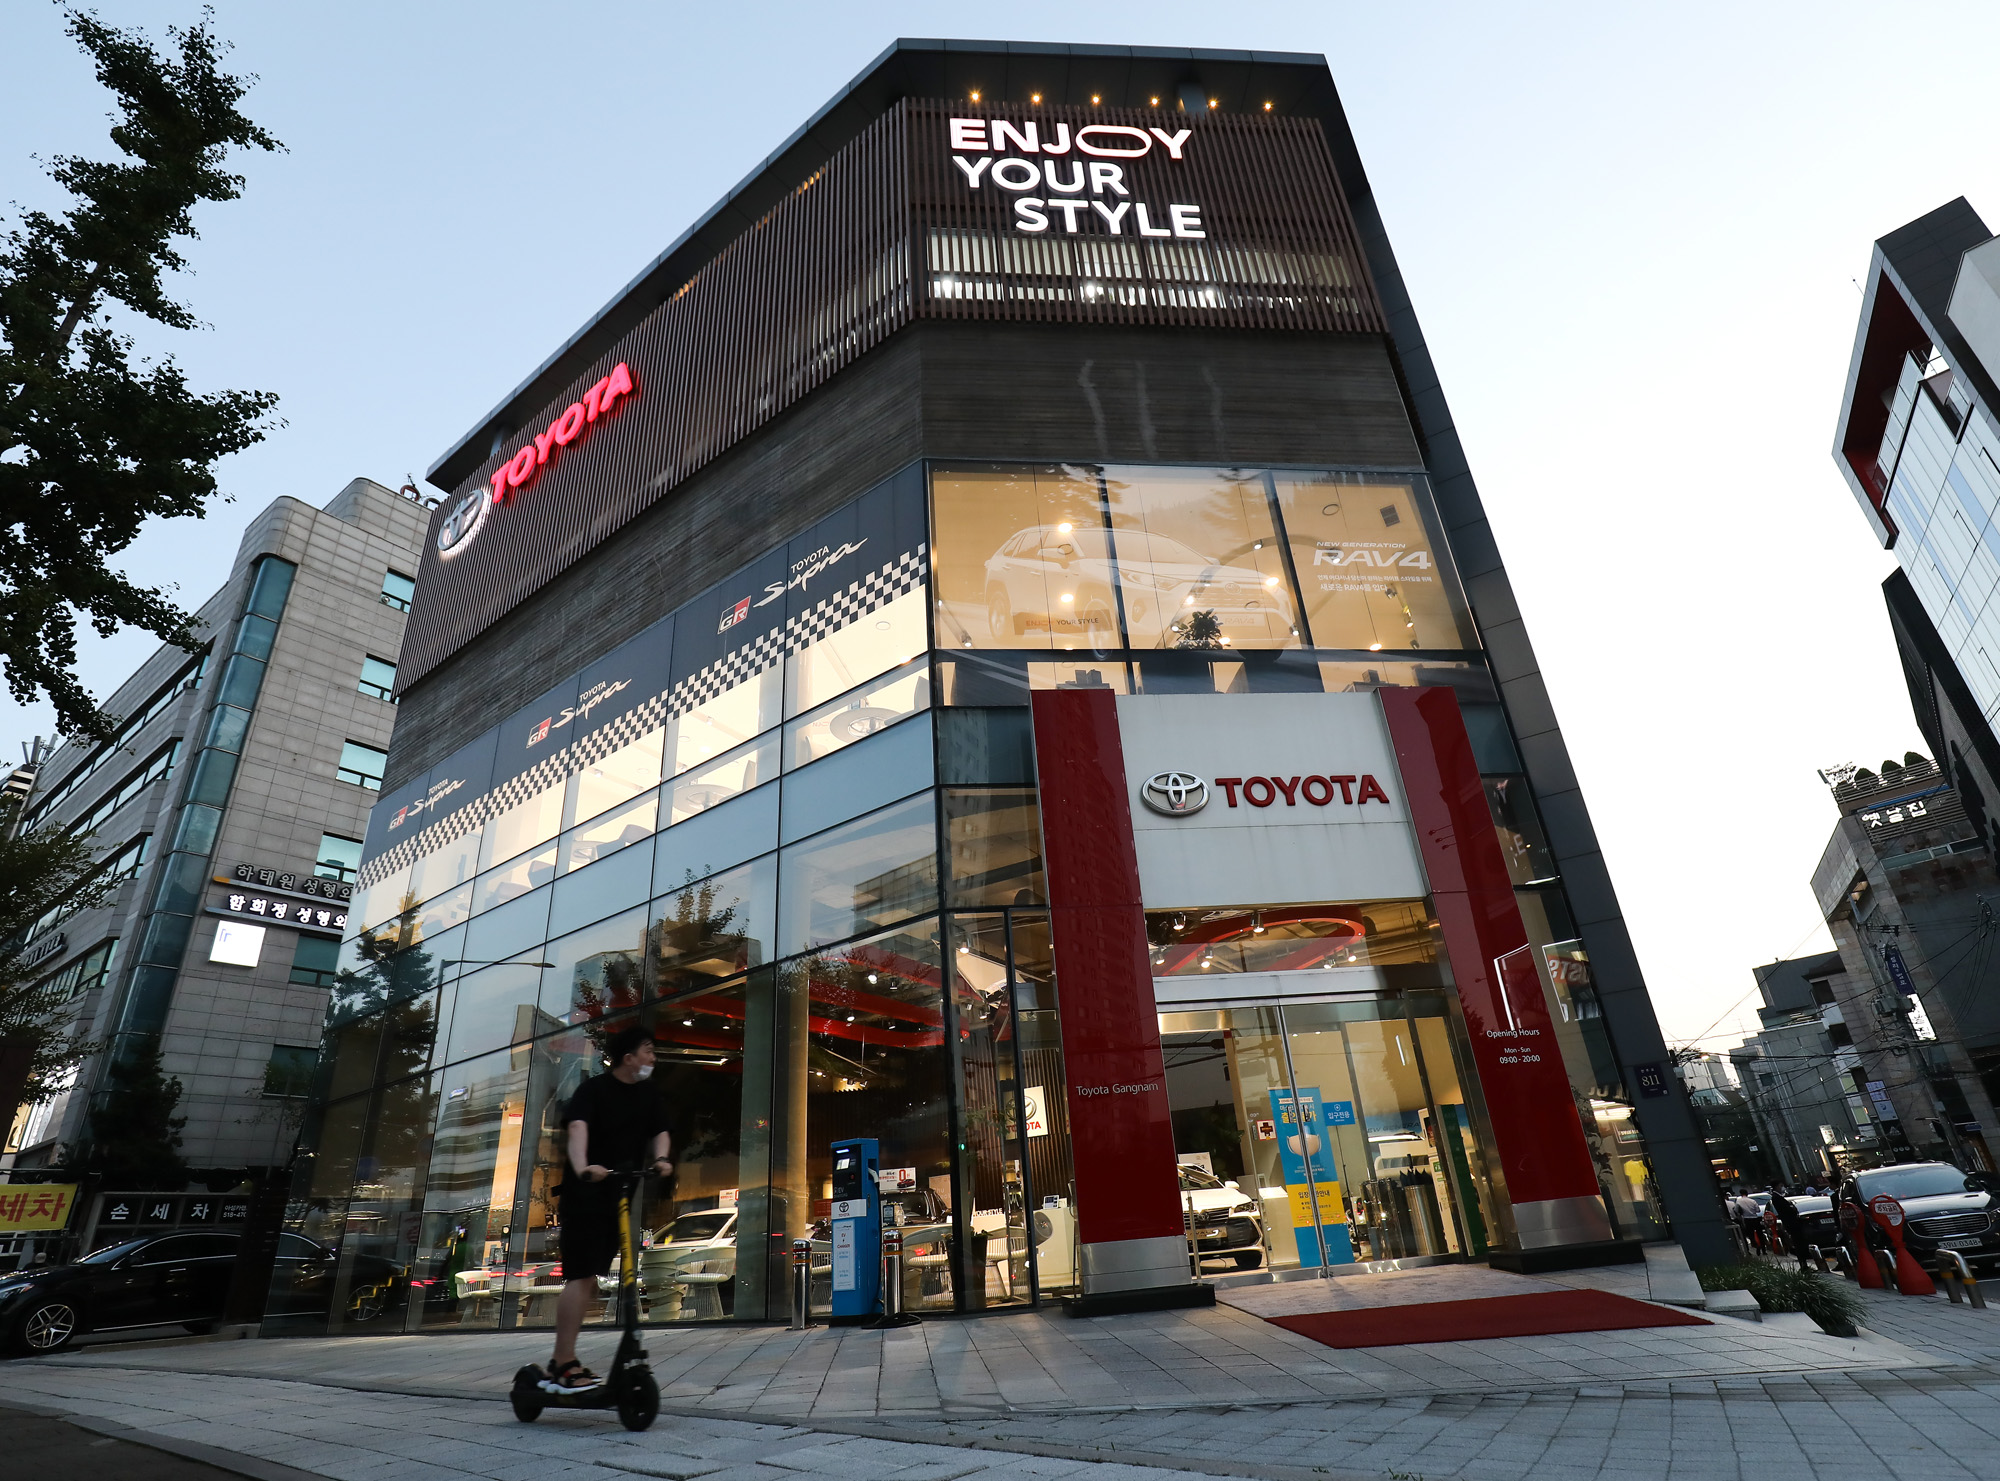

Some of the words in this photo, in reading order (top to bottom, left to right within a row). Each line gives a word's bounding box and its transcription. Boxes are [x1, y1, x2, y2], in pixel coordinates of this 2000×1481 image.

[950, 118, 1192, 159] ENJOY
[952, 155, 1130, 195] YOUR
[1014, 197, 1206, 239] STYLE
[490, 361, 633, 504] TOYOTA
[790, 545, 830, 574] TOYOTA
[1313, 549, 1432, 569] RAV4
[721, 605, 748, 629] GR
[753, 537, 868, 608] Supra
[551, 678, 632, 729] Supra
[578, 681, 607, 702] TOYOTA
[407, 778, 467, 817] Supra
[428, 778, 449, 796] TOYOTA
[1215, 774, 1390, 807] TOYOTA
[1861, 800, 1928, 828] 옛날집
[236, 863, 296, 891] 하태원
[228, 894, 289, 920] 함희정
[1486, 1030, 1518, 1039] Opening
[1519, 1028, 1540, 1036] Hours
[1499, 1056, 1518, 1064] 09:00
[1522, 1054, 1541, 1063] 20:00
[1076, 1086, 1109, 1098] Toyota
[1112, 1082, 1159, 1096] Gangnam
[1641, 1074, 1661, 1087] 811
[1005, 1120, 1042, 1134] TOOTA
[1327, 1110, 1351, 1120] 입구전용
[0, 1192, 66, 1222] 세차
